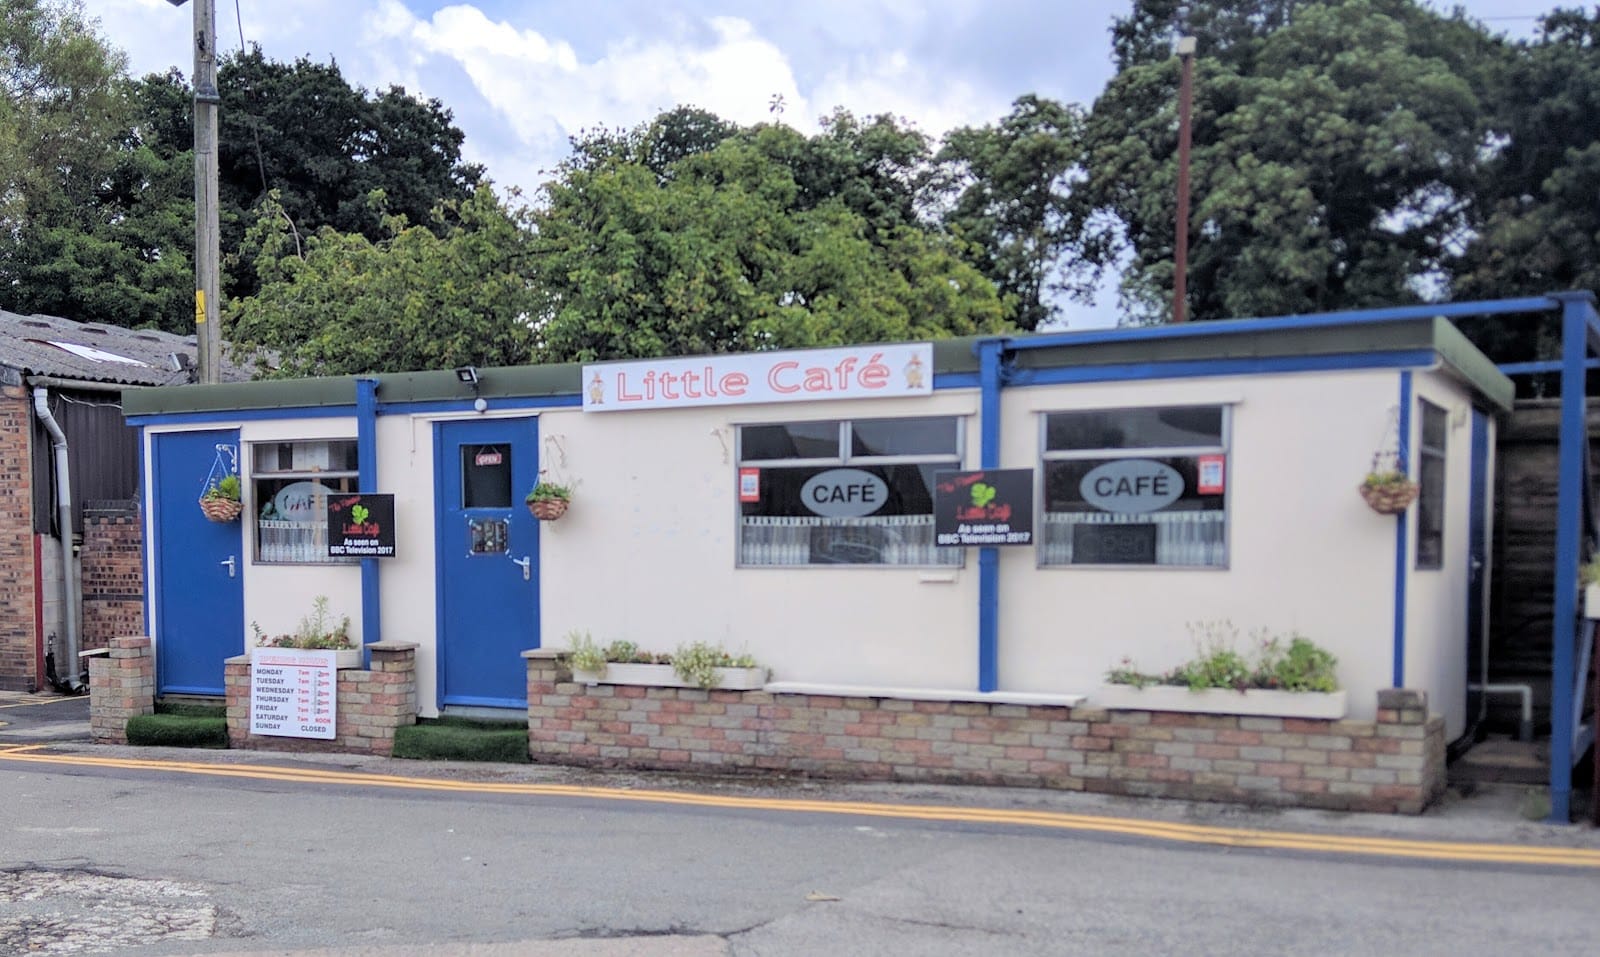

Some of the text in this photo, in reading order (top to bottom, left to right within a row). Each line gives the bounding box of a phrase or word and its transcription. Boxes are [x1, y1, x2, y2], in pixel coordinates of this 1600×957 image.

[617, 353, 891, 402] Little Café
[812, 478, 876, 504] CAFÉ
[1094, 469, 1169, 497] CAFÉ
[345, 546, 377, 554] Television
[377, 546, 393, 554] 2017
[256, 695, 289, 703] THURSDAY
